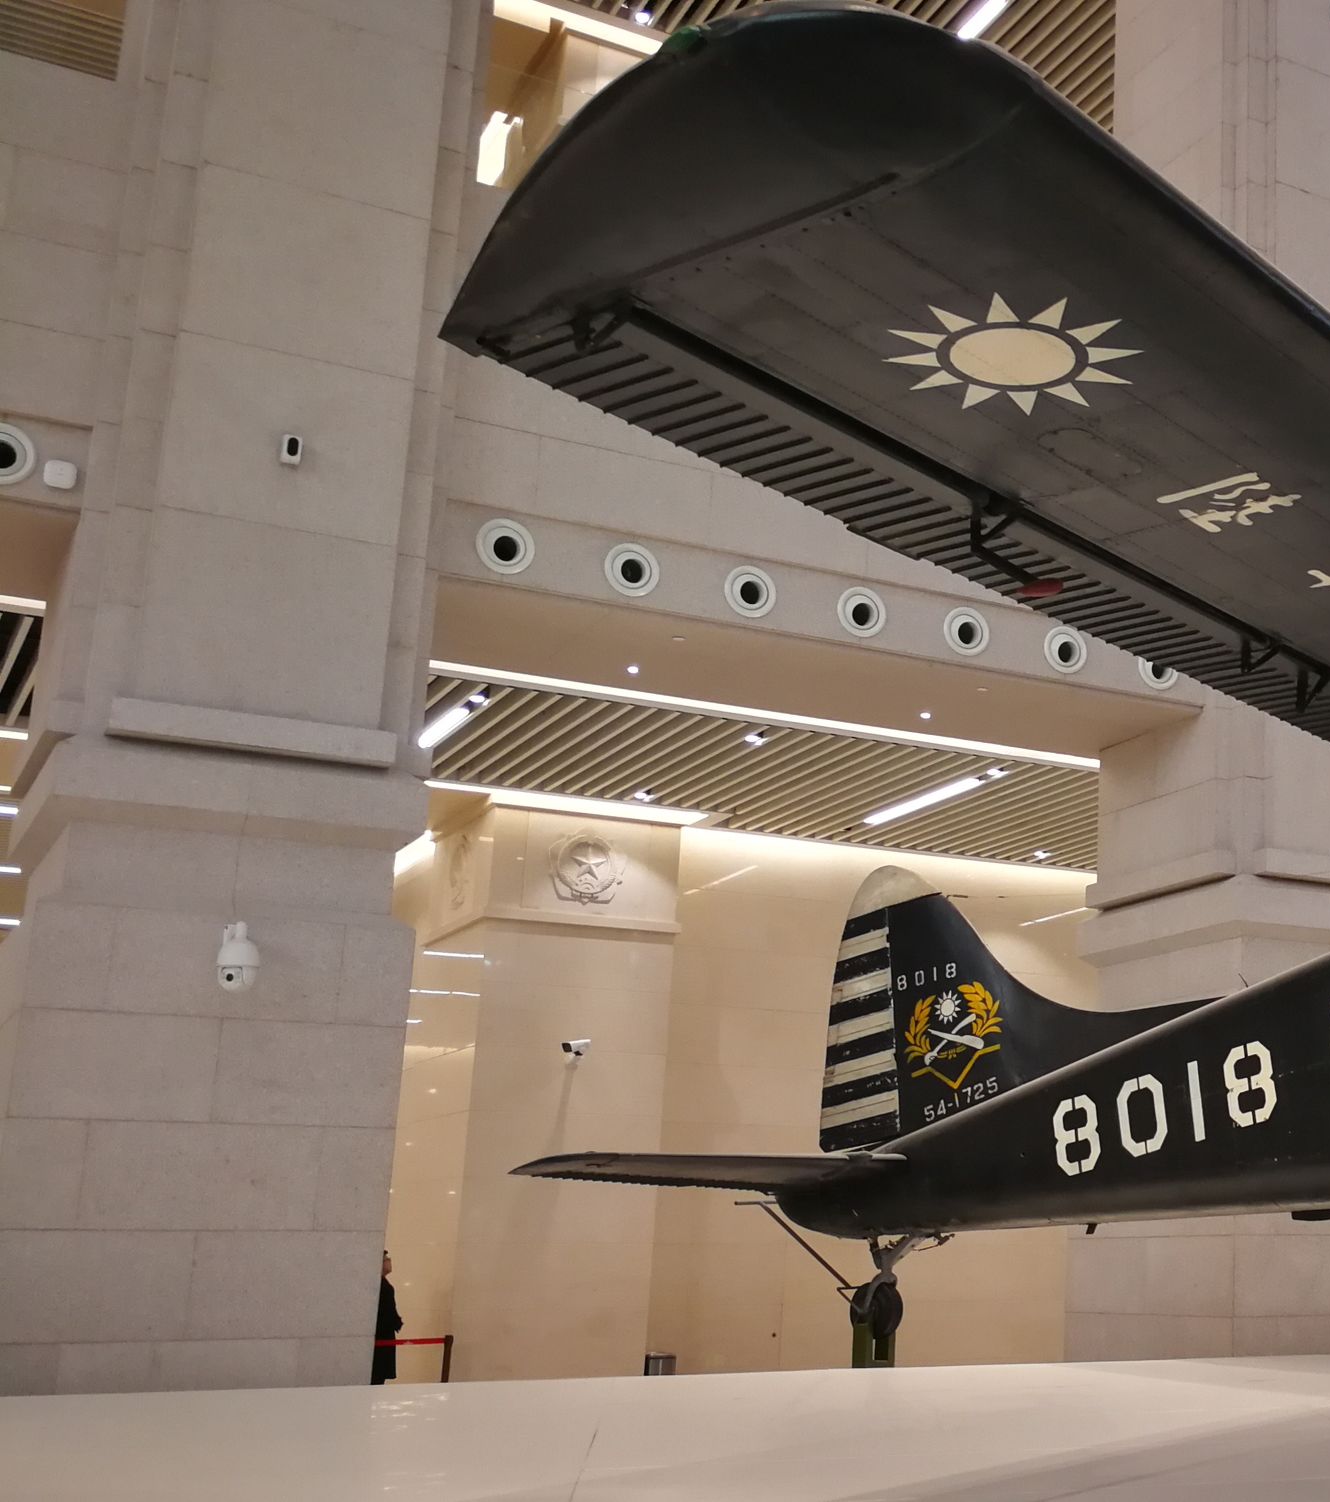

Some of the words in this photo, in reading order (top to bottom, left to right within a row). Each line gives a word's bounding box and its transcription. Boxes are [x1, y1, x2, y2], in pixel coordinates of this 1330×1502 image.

[896, 963, 957, 991] 8018
[924, 1077, 998, 1122] 54-1725
[1052, 1041, 1278, 1177] 8018
